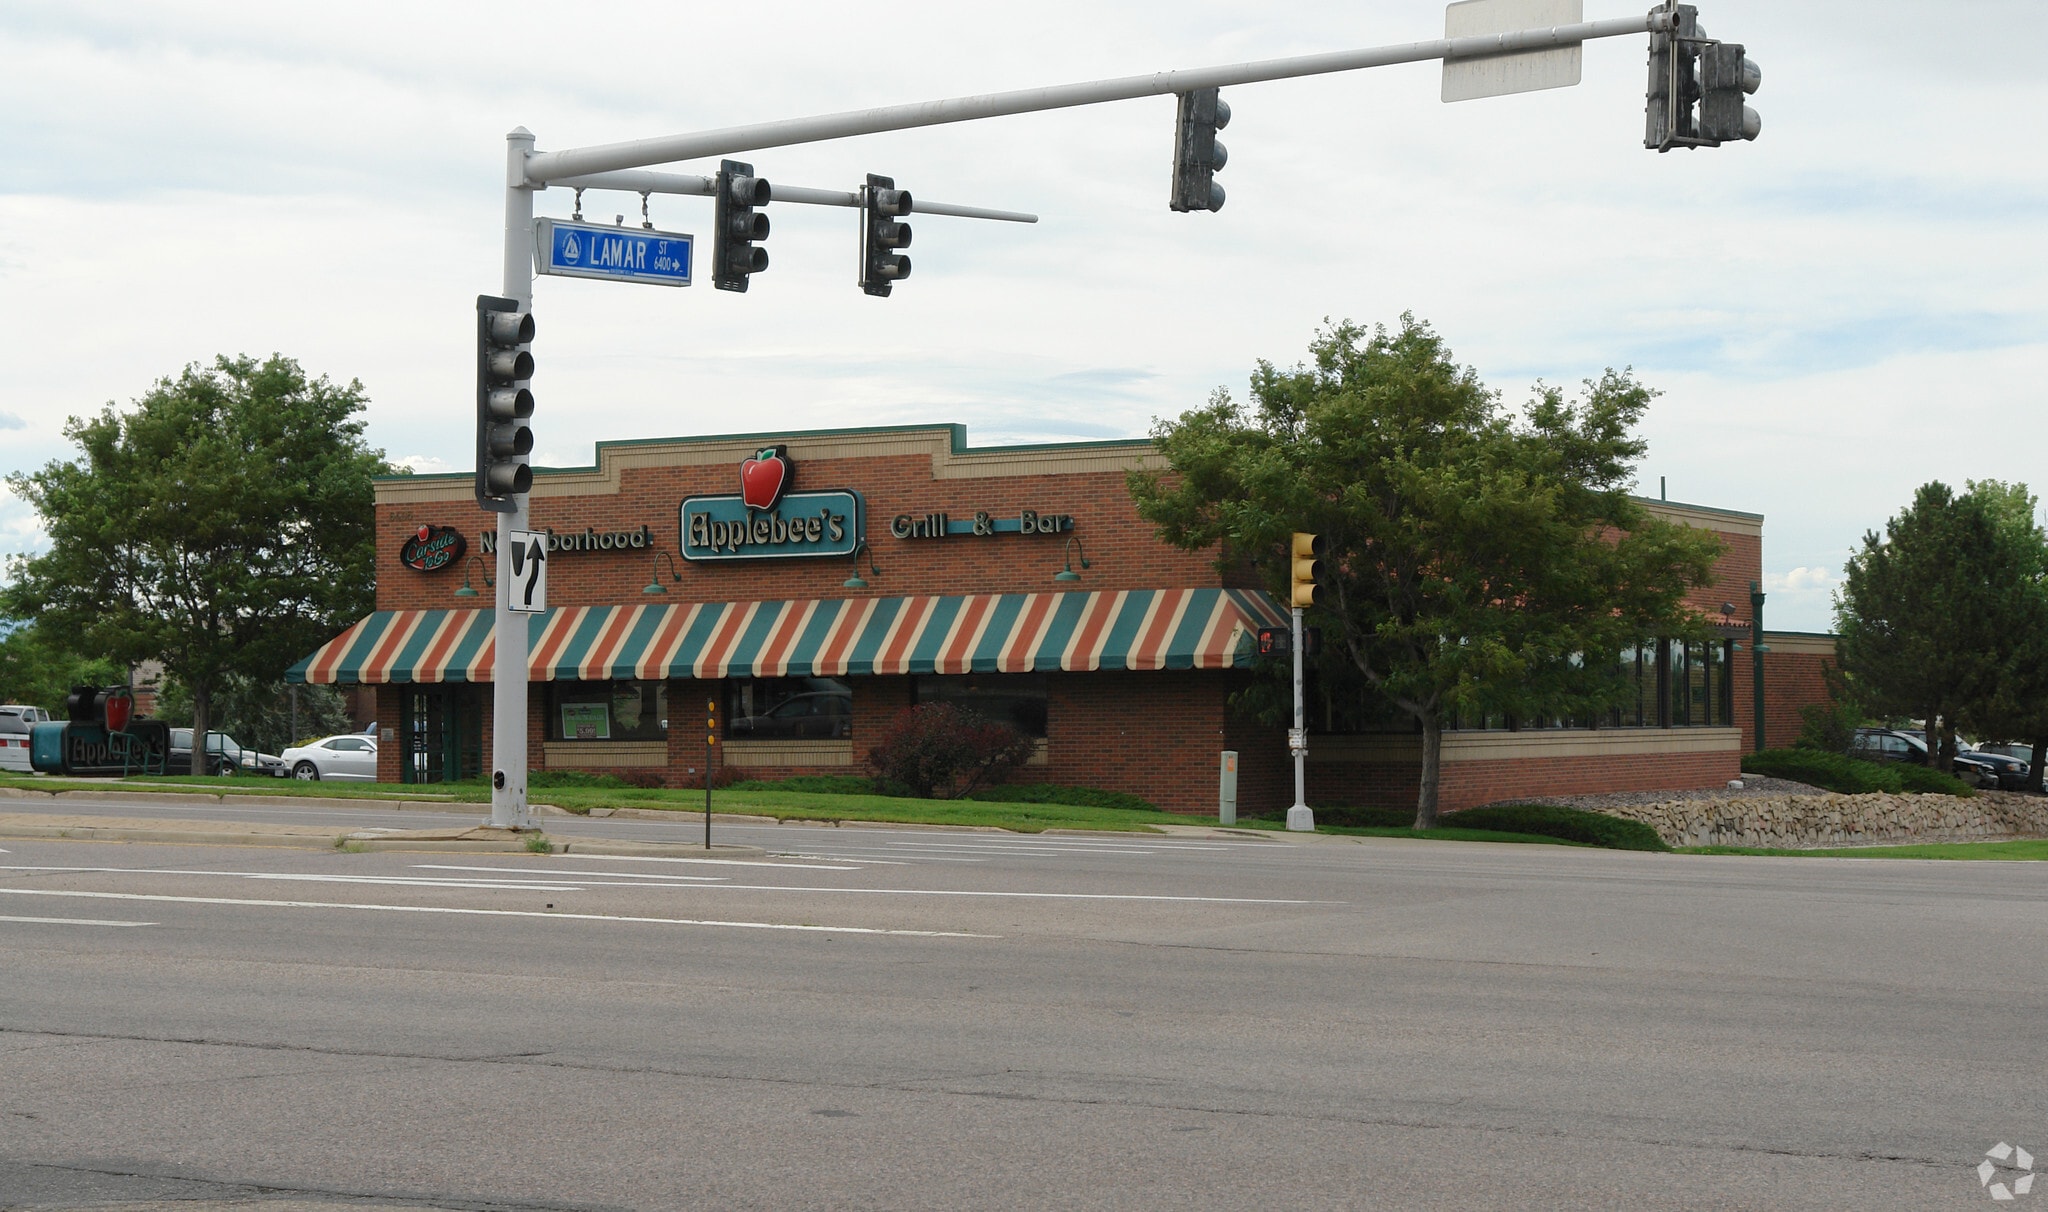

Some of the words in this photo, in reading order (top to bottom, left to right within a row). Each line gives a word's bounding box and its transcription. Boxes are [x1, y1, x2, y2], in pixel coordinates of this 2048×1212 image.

[590, 236, 646, 269] LAMAR
[658, 240, 668, 255] ST
[654, 256, 671, 271] 6400
[481, 525, 648, 553] Nborhood
[688, 508, 845, 553] Applebee's
[891, 513, 947, 539] Grill
[972, 511, 994, 536] &
[1020, 510, 1069, 534] Bar
[406, 533, 455, 562] Carside
[434, 550, 450, 566] Go
